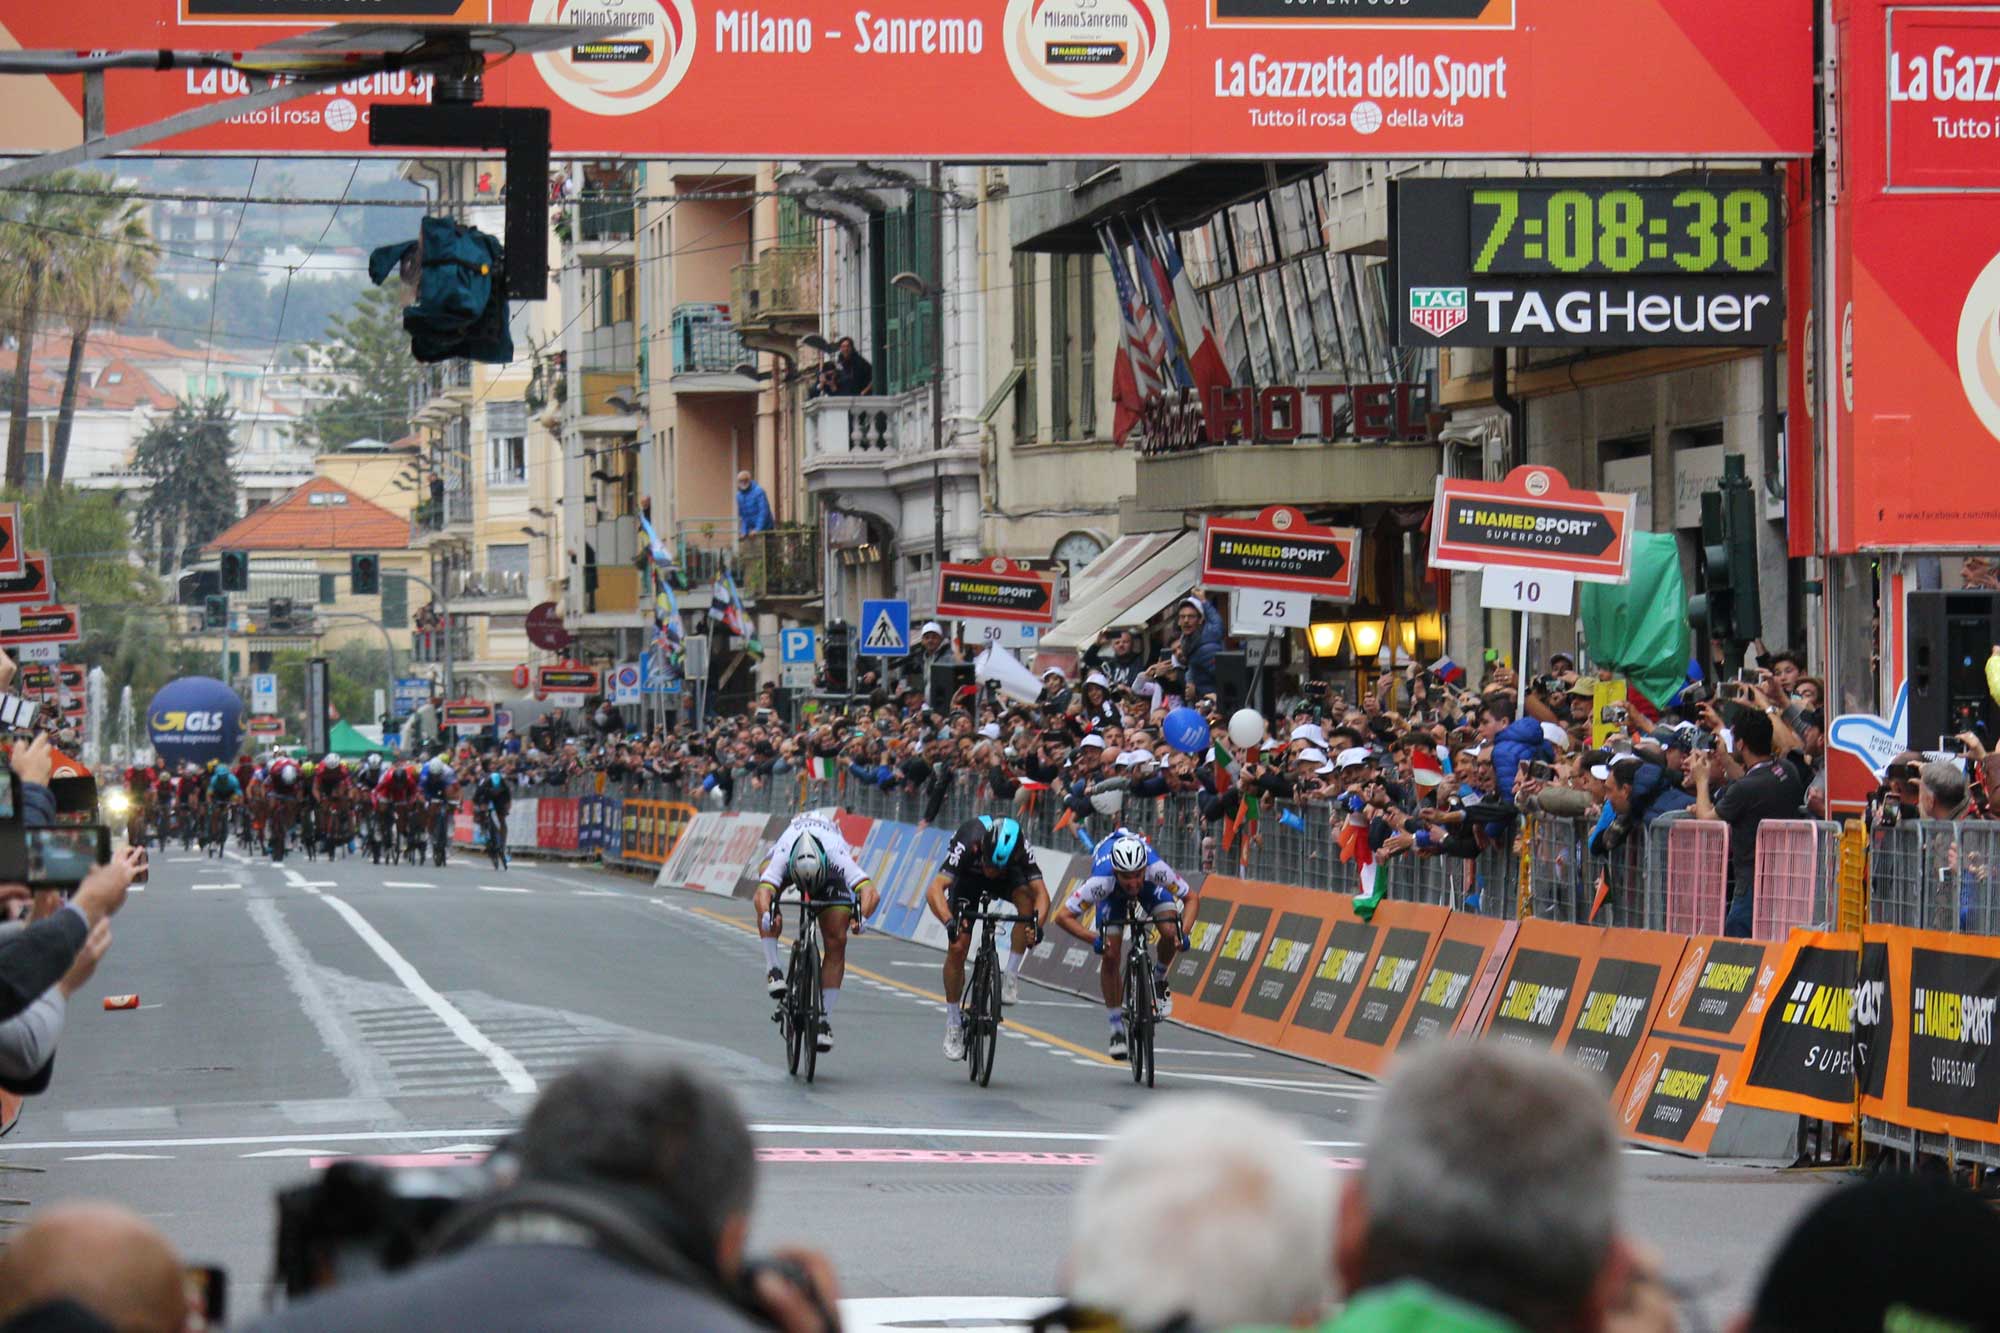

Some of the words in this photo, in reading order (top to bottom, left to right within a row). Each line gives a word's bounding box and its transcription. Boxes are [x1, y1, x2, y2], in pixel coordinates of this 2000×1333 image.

[716, 10, 812, 53] Milano
[854, 11, 984, 54] Sanremo
[1215, 55, 1245, 98] La
[1249, 53, 1363, 98] Gazzetta
[1368, 54, 1430, 99] dello
[1434, 54, 1507, 106] Sport
[1890, 51, 1928, 102] La
[271, 105, 280, 125] il
[283, 110, 321, 125] rosa
[1248, 109, 1295, 128] Tutto
[1297, 107, 1307, 128] il
[1310, 111, 1347, 128] rosa
[1387, 108, 1428, 128] della
[1431, 108, 1465, 128] vita
[1932, 116, 1992, 139] Tutto
[1473, 189, 1769, 273] 7:08:38
[1414, 291, 1463, 307] TAG
[1412, 308, 1467, 333] HEUER
[1210, 383, 1431, 443] HOTEL
[1474, 510, 1593, 537] NAMEDSPORT
[1486, 530, 1562, 546] SUPERFOOD
[1232, 542, 1326, 562] NAMEDSPORT
[1242, 558, 1302, 570] SUPERFOOD
[960, 582, 1034, 598] NAMEDSPORT
[1513, 580, 1541, 602] 10
[1262, 599, 1287, 618] 25
[983, 626, 1002, 640] 50
[185, 710, 223, 732] GLS
[1925, 989, 1995, 1046] NAMEDSPORT
[1930, 1055, 1977, 1088] SUPERFOOD
